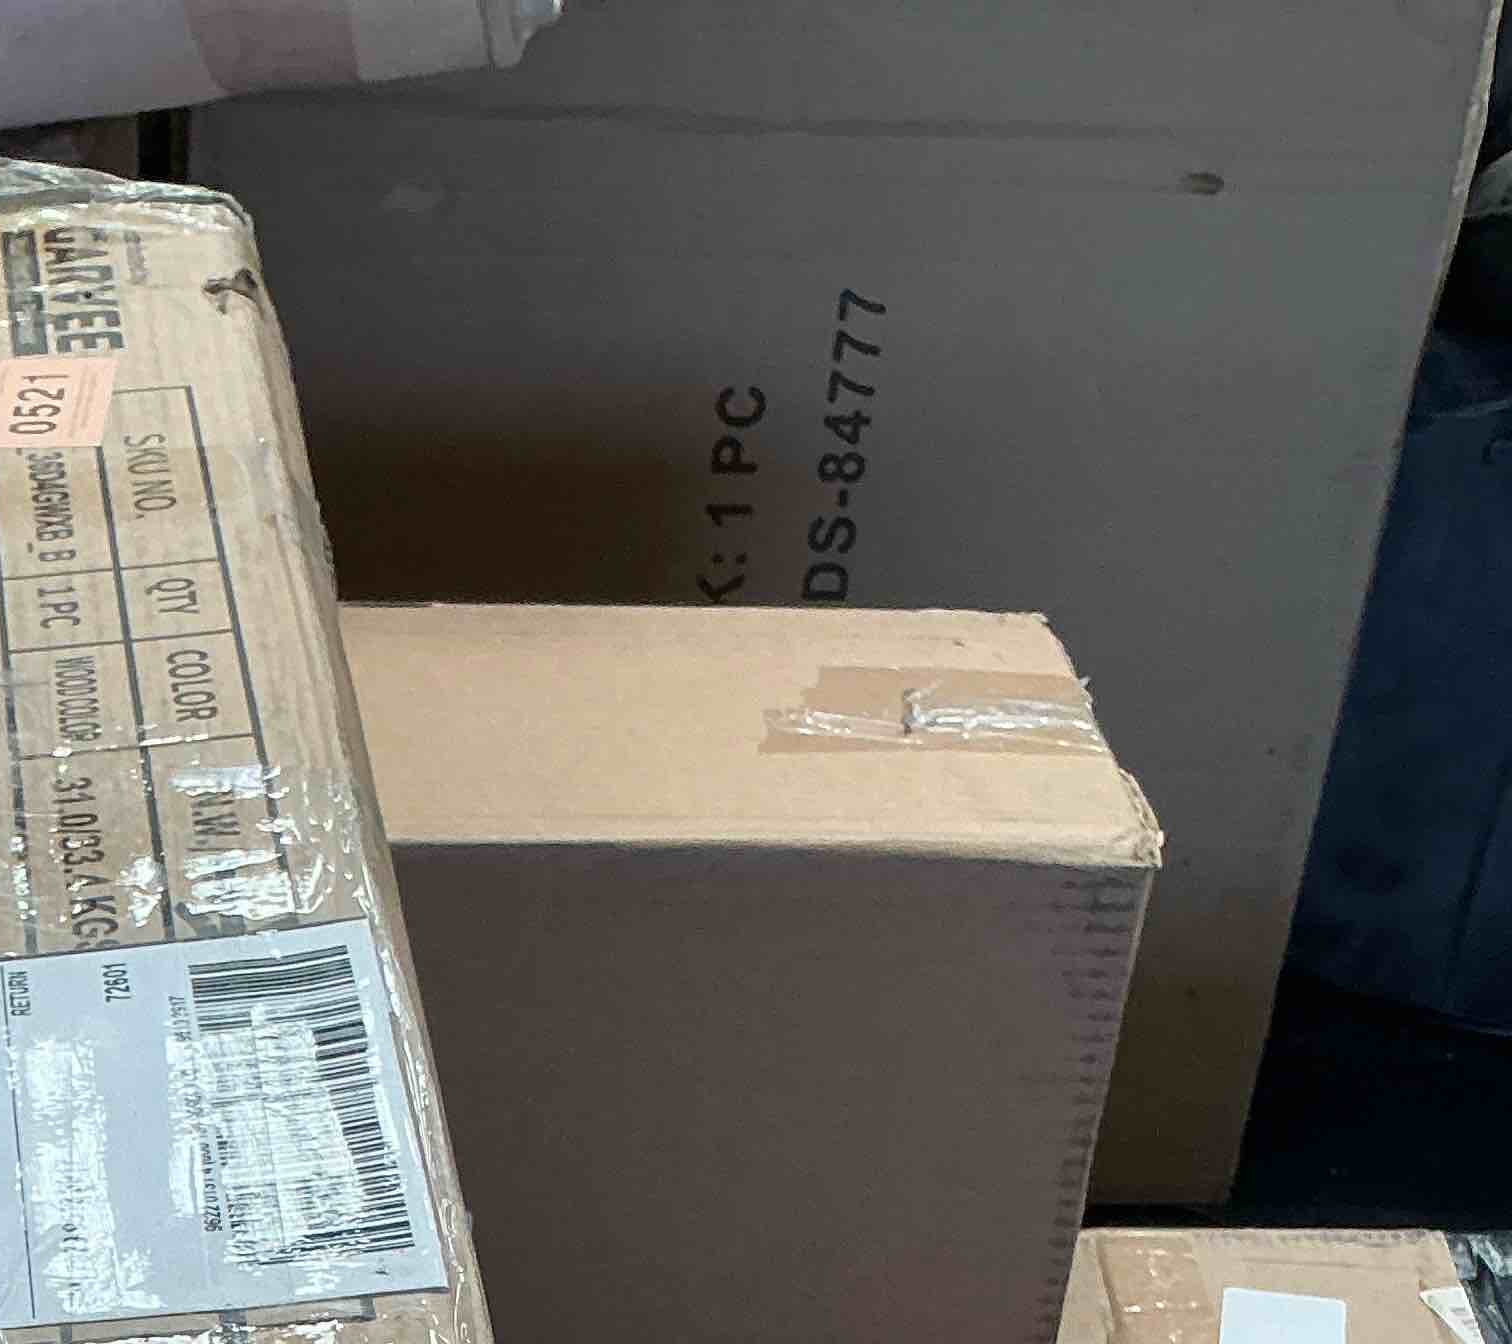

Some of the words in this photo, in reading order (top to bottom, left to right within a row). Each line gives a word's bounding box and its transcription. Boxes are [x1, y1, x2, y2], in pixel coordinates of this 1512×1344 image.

[8, 372, 71, 437] 0521
[710, 386, 768, 477] PC
[801, 288, 887, 602] DS-84777
[122, 433, 171, 475] SKU
[130, 480, 177, 519] NO.
[704, 503, 755, 528] 1
[37, 602, 82, 630] PC
[144, 577, 199, 615] QTY
[165, 649, 218, 723] COLOR
[7, 970, 32, 1016] RETURN
[102, 962, 132, 1003] 72601
